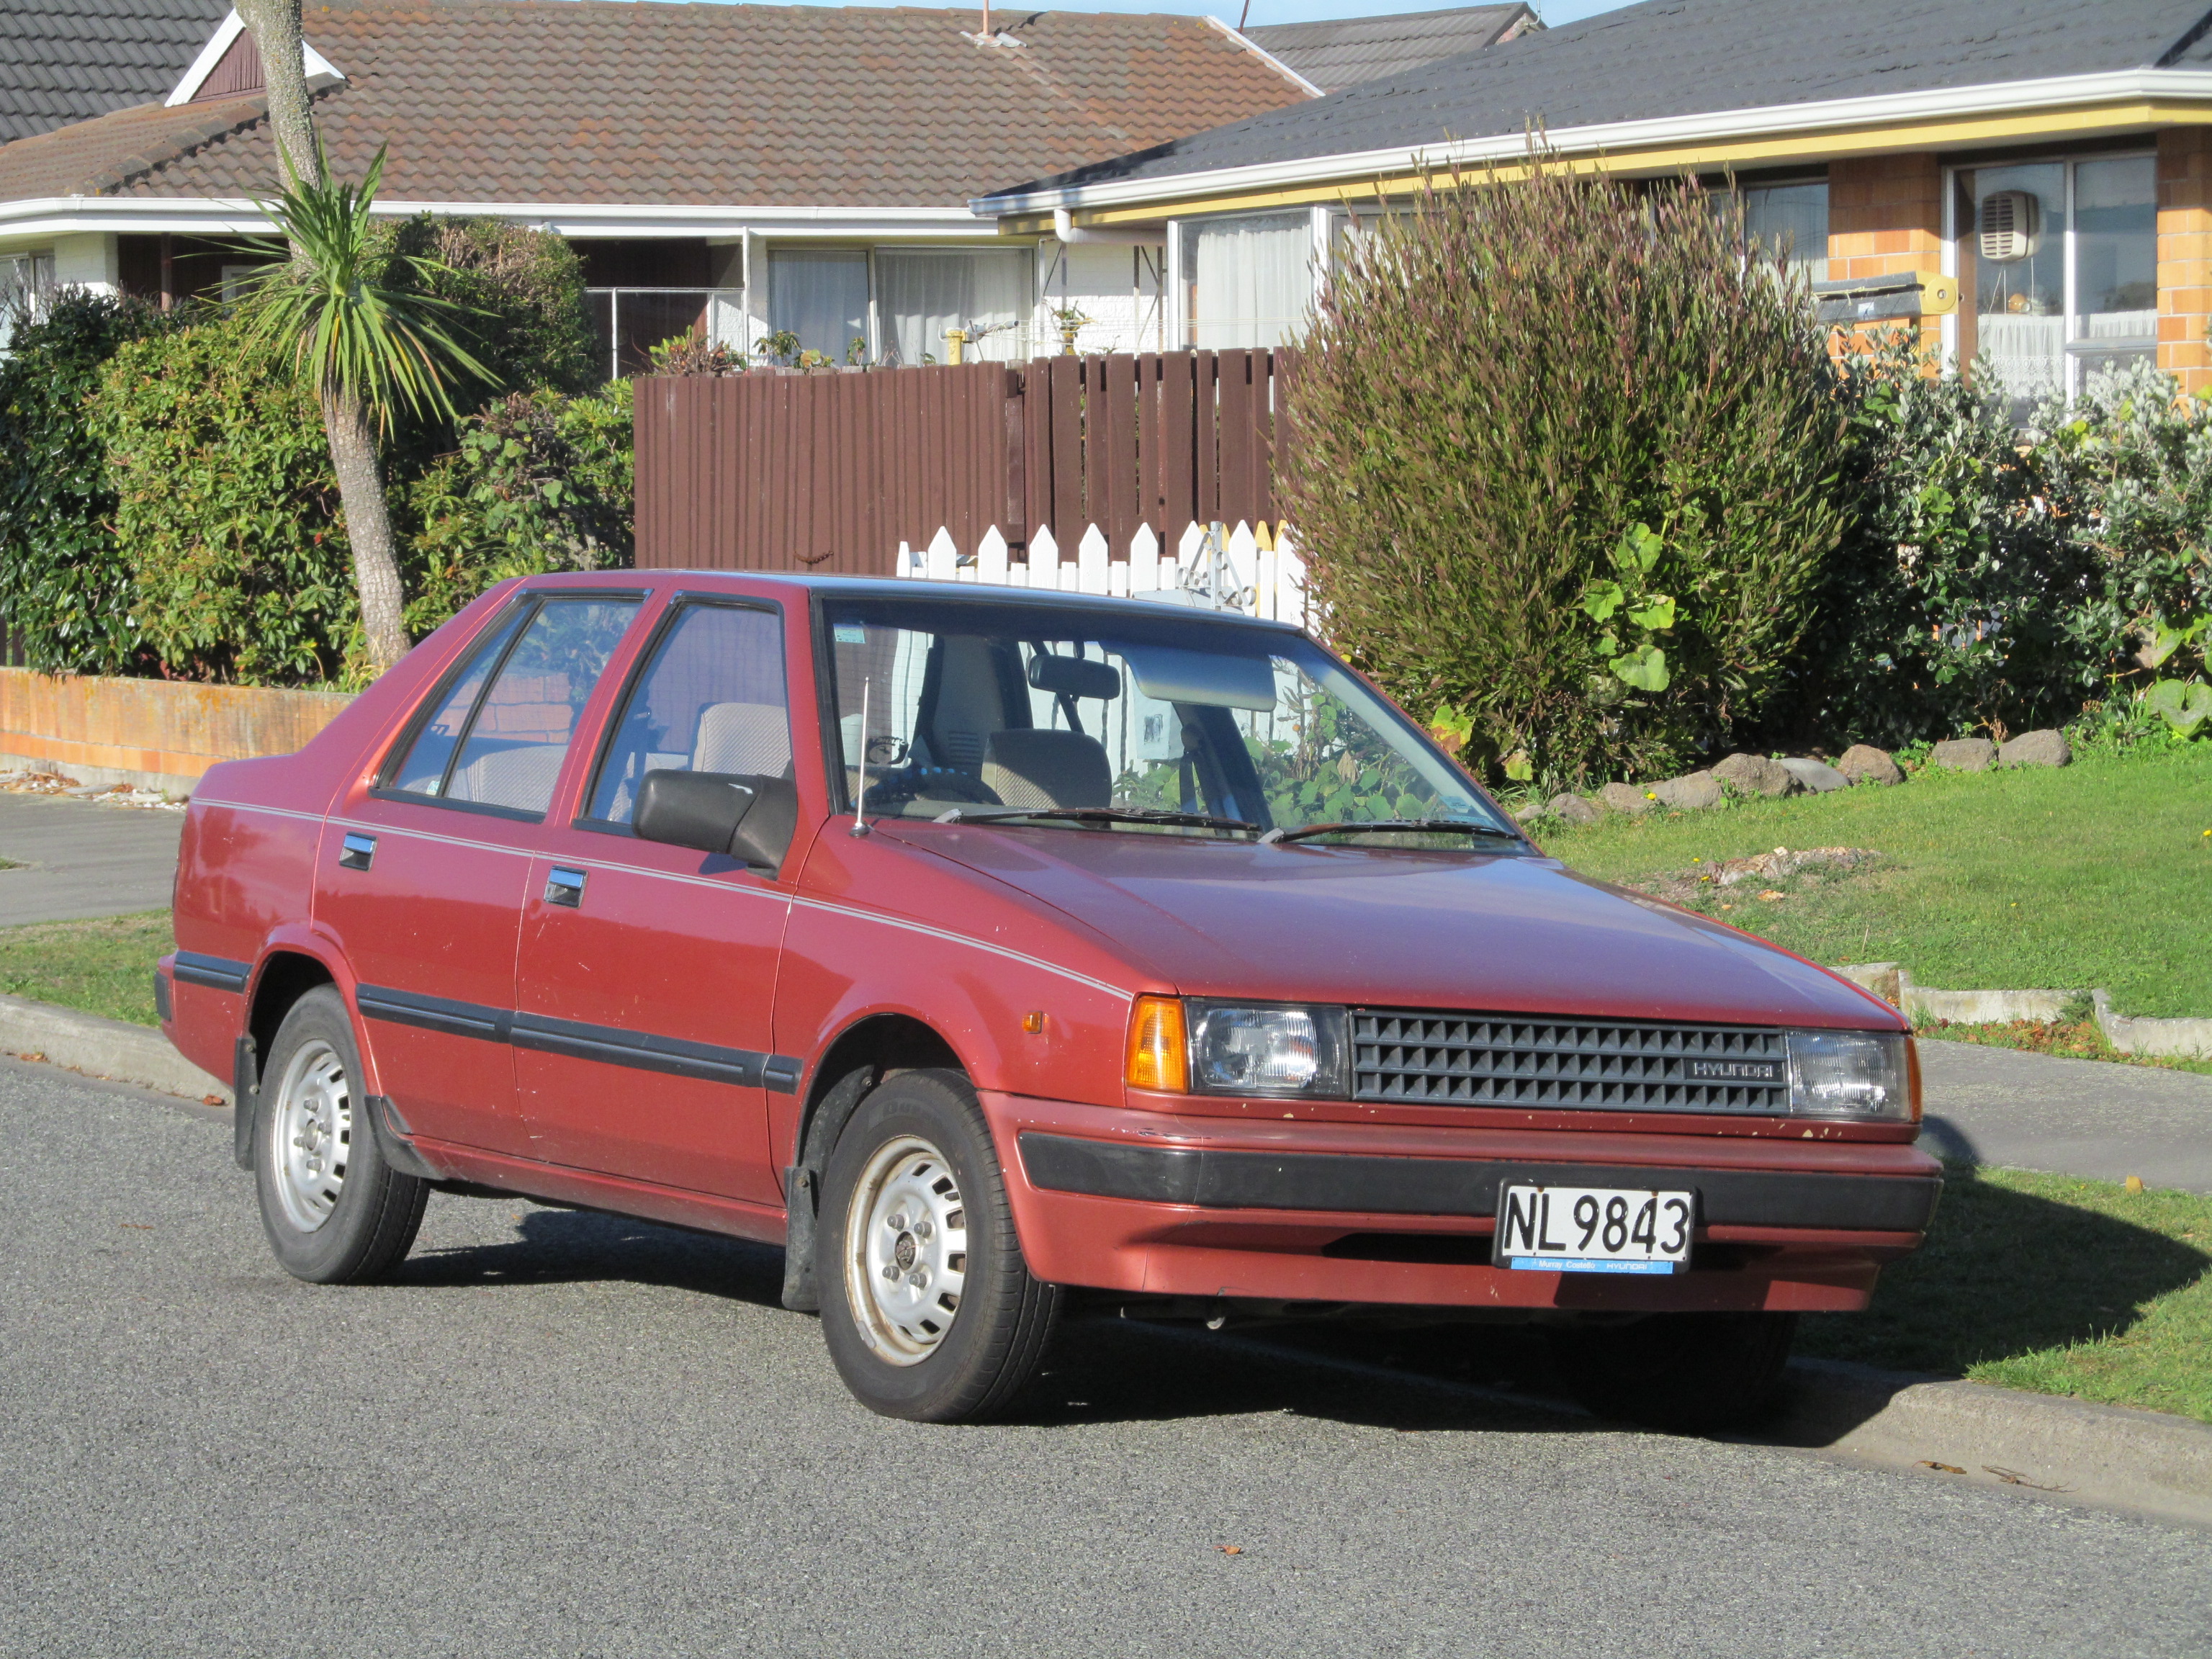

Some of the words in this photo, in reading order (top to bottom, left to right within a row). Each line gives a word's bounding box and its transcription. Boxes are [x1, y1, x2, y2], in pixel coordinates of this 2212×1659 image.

[1694, 1062, 1773, 1077] HYUNDAI
[1539, 1260, 1563, 1269] Murray
[1566, 1261, 1596, 1269] Costello
